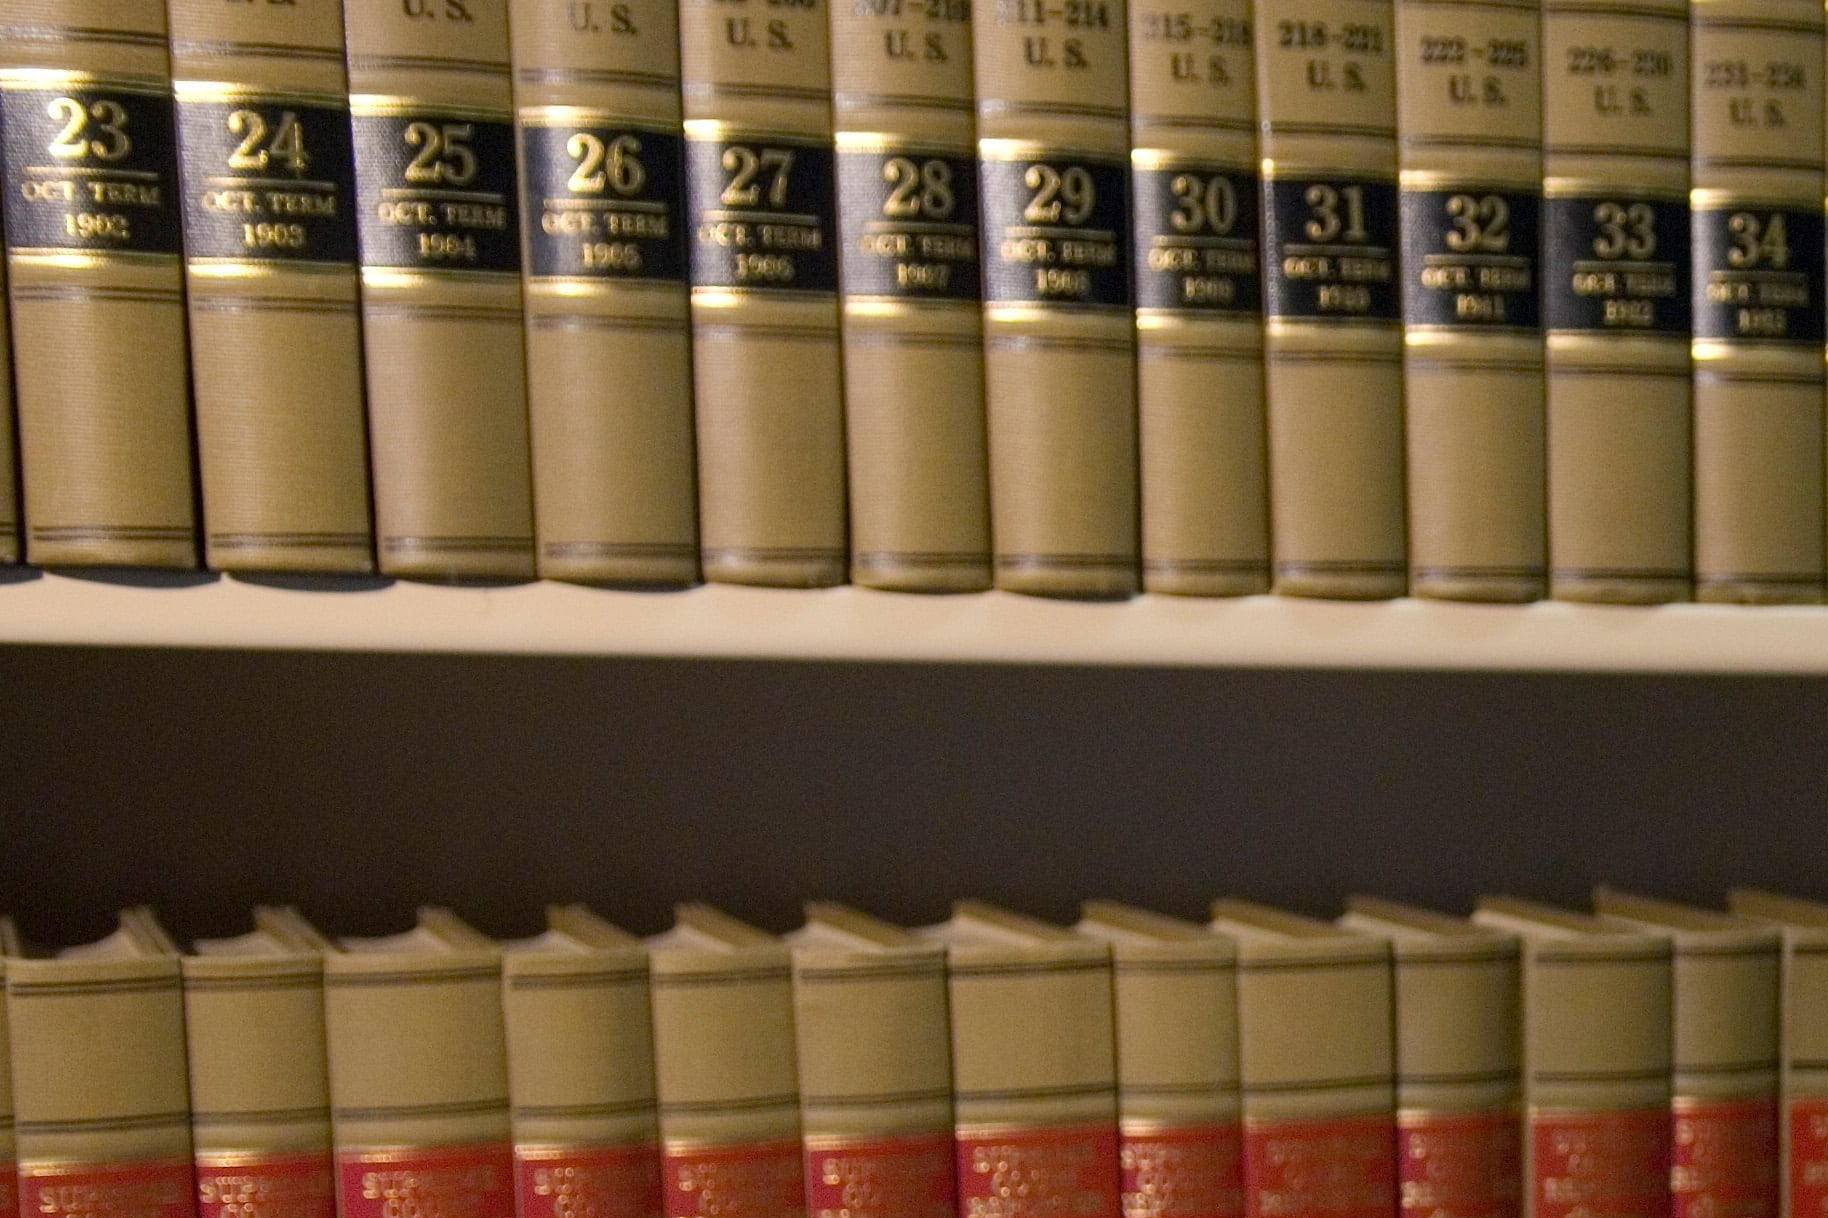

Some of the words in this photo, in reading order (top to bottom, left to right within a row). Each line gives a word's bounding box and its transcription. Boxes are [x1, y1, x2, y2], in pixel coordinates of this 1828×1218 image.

[47, 96, 132, 160] 23
[227, 109, 308, 171] 24
[404, 122, 477, 185] 25
[566, 132, 646, 195] 26
[721, 146, 797, 207] 27
[882, 157, 954, 218] 28
[88, 182, 161, 204] TERM
[266, 191, 336, 217] TERM
[446, 204, 507, 230] TERM
[1024, 164, 1096, 225] 29
[1171, 174, 1238, 233] 30
[1305, 184, 1368, 242] 31
[604, 213, 670, 239] TERM
[1446, 194, 1509, 251] 32
[1593, 202, 1657, 260] 33
[1728, 212, 1790, 269] 34
